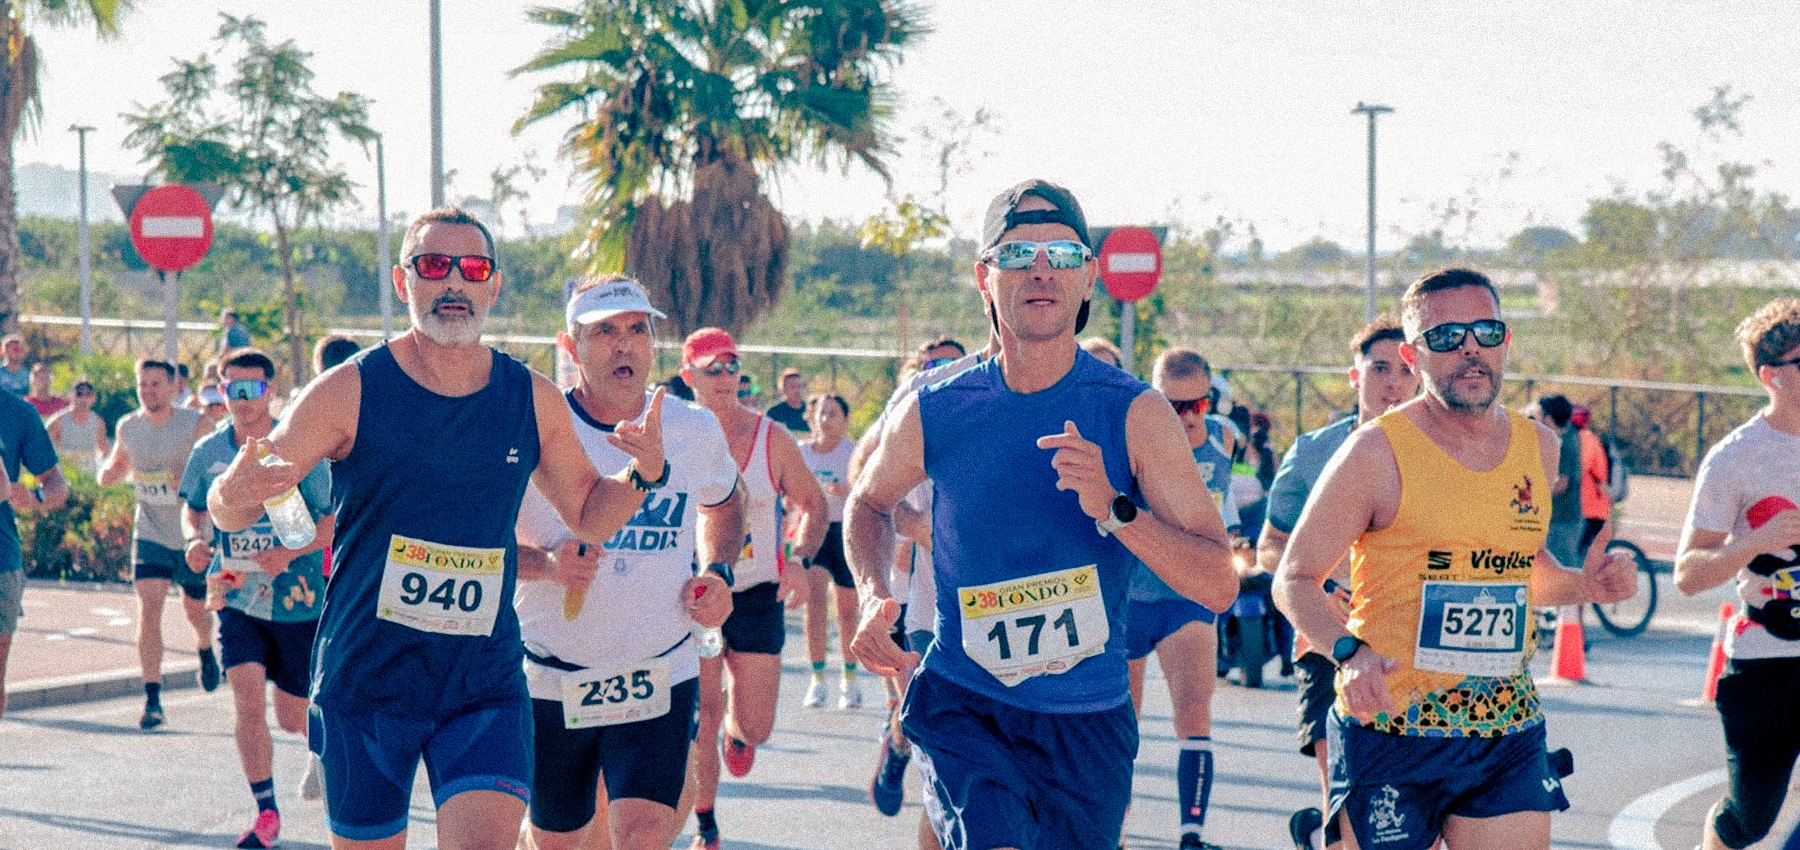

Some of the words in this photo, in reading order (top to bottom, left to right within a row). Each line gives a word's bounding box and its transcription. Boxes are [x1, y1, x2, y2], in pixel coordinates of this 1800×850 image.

[231, 537, 272, 551] 5242
[406, 544, 427, 561] 38
[426, 553, 483, 569] FONDO
[400, 572, 483, 612] 940
[976, 591, 998, 610] 38
[998, 583, 1069, 608] FONDO
[988, 608, 1080, 660] 171
[1444, 607, 1514, 636] 5273
[578, 669, 655, 707] 235
